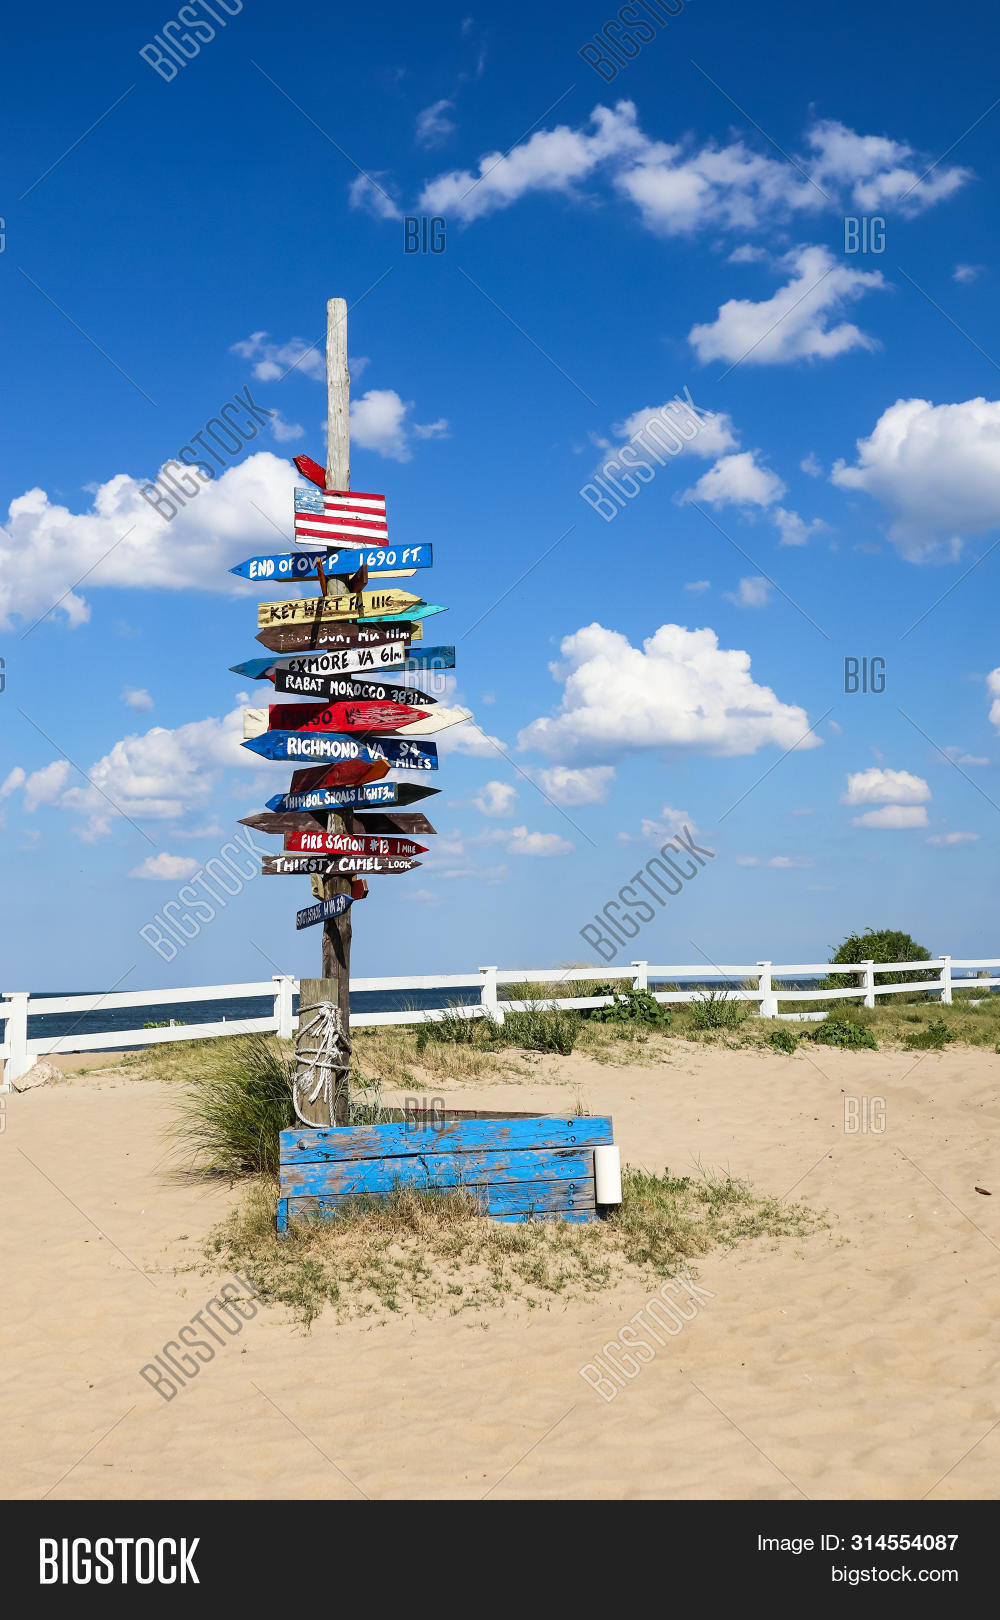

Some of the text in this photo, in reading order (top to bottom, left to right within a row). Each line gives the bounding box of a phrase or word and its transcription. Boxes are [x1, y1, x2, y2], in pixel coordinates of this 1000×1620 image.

[249, 559, 275, 579] END
[279, 556, 295, 573] OF
[359, 551, 396, 567] 1690
[402, 546, 422, 563] FT.
[270, 603, 299, 620] KEY
[289, 651, 349, 673] EXMORE
[358, 650, 374, 666] VA
[285, 675, 324, 692] RABAT
[330, 680, 385, 700] MOROCCO
[287, 737, 358, 759] RICHMOND
[365, 742, 388, 761] VA
[395, 758, 432, 769] MILES
[300, 833, 323, 849] FIRE
[325, 834, 366, 852] STATION
[401, 844, 416, 854] MILE
[271, 857, 335, 873] THIRSTY
[338, 857, 382, 871] CAMEL
